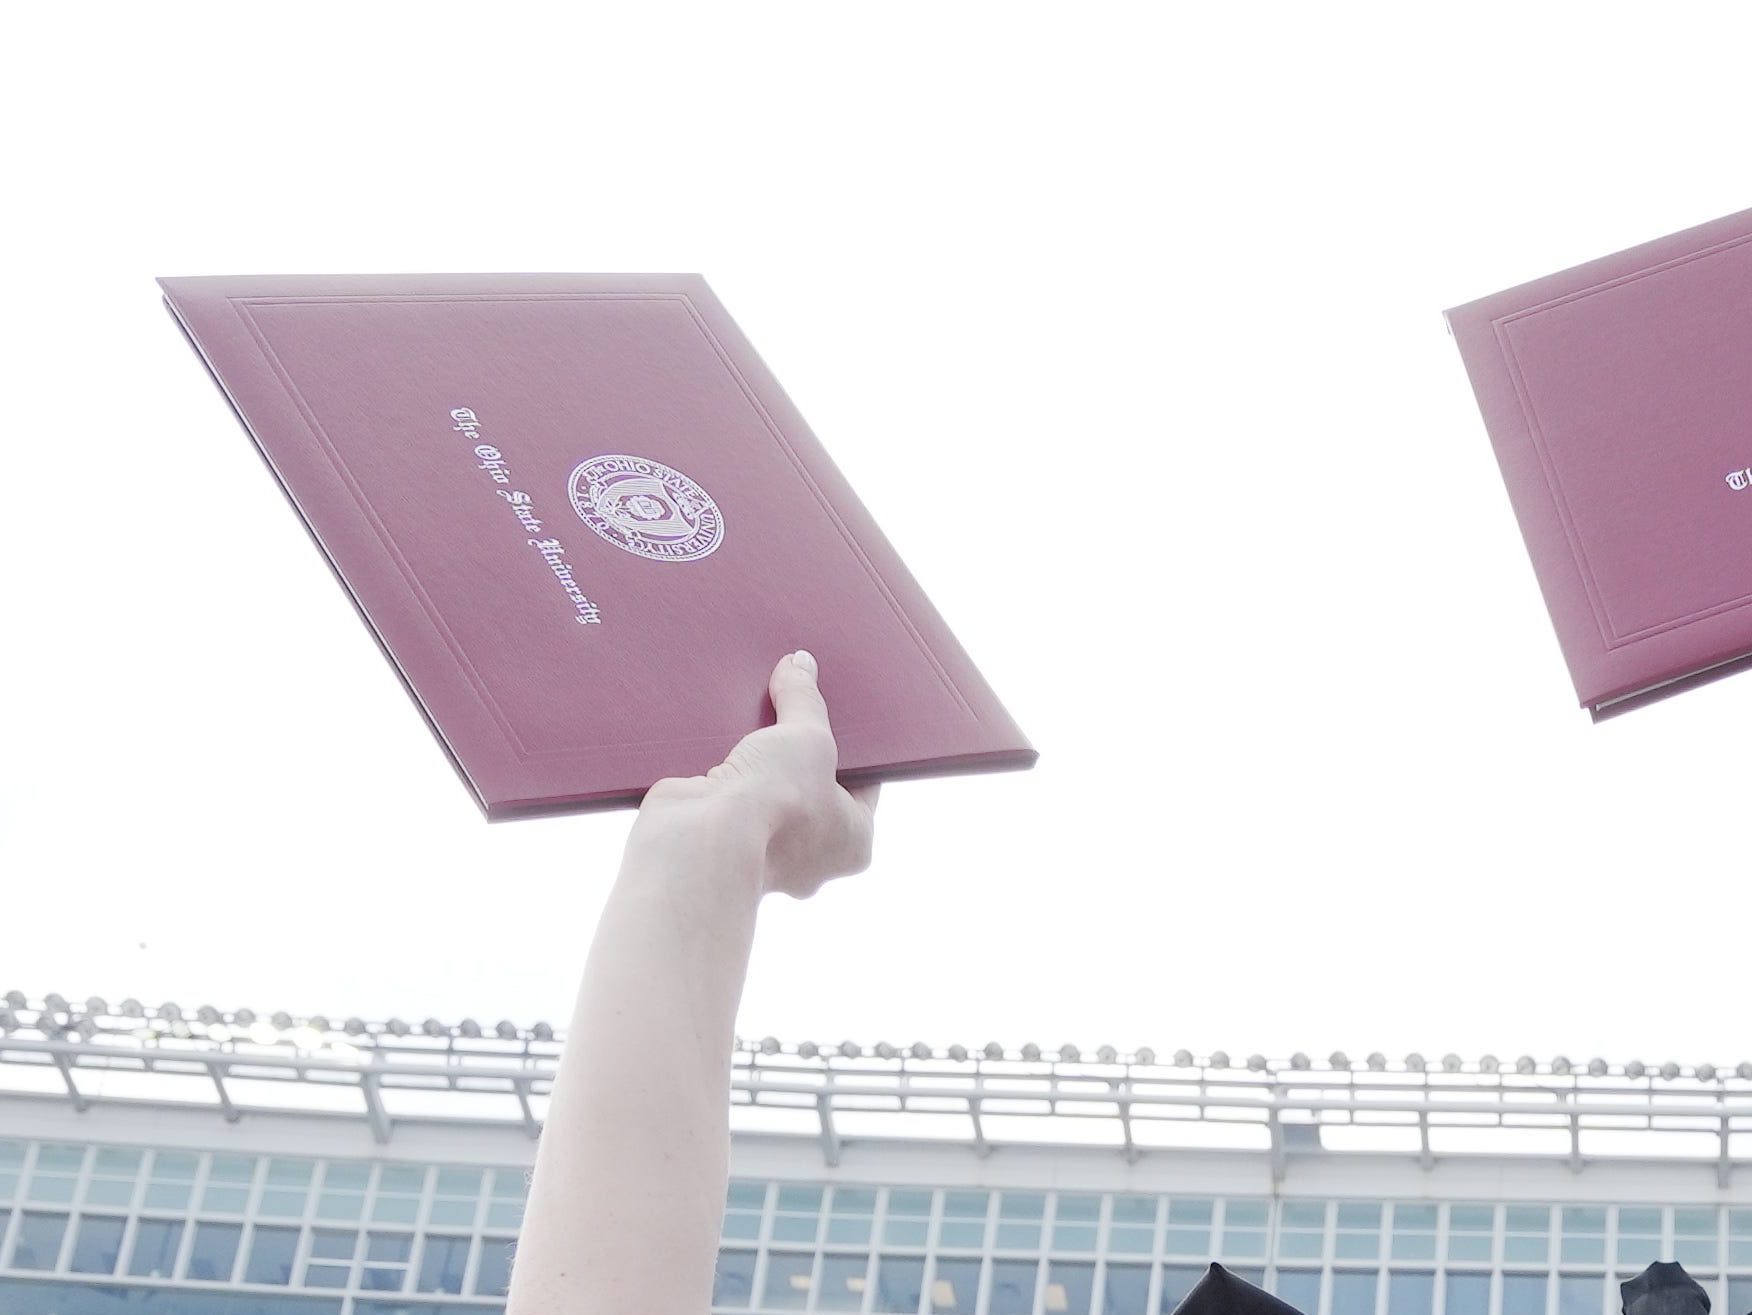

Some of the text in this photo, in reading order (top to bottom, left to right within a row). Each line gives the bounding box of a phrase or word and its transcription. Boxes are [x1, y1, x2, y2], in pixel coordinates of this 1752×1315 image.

[450, 407, 601, 625] The Ohio State University
